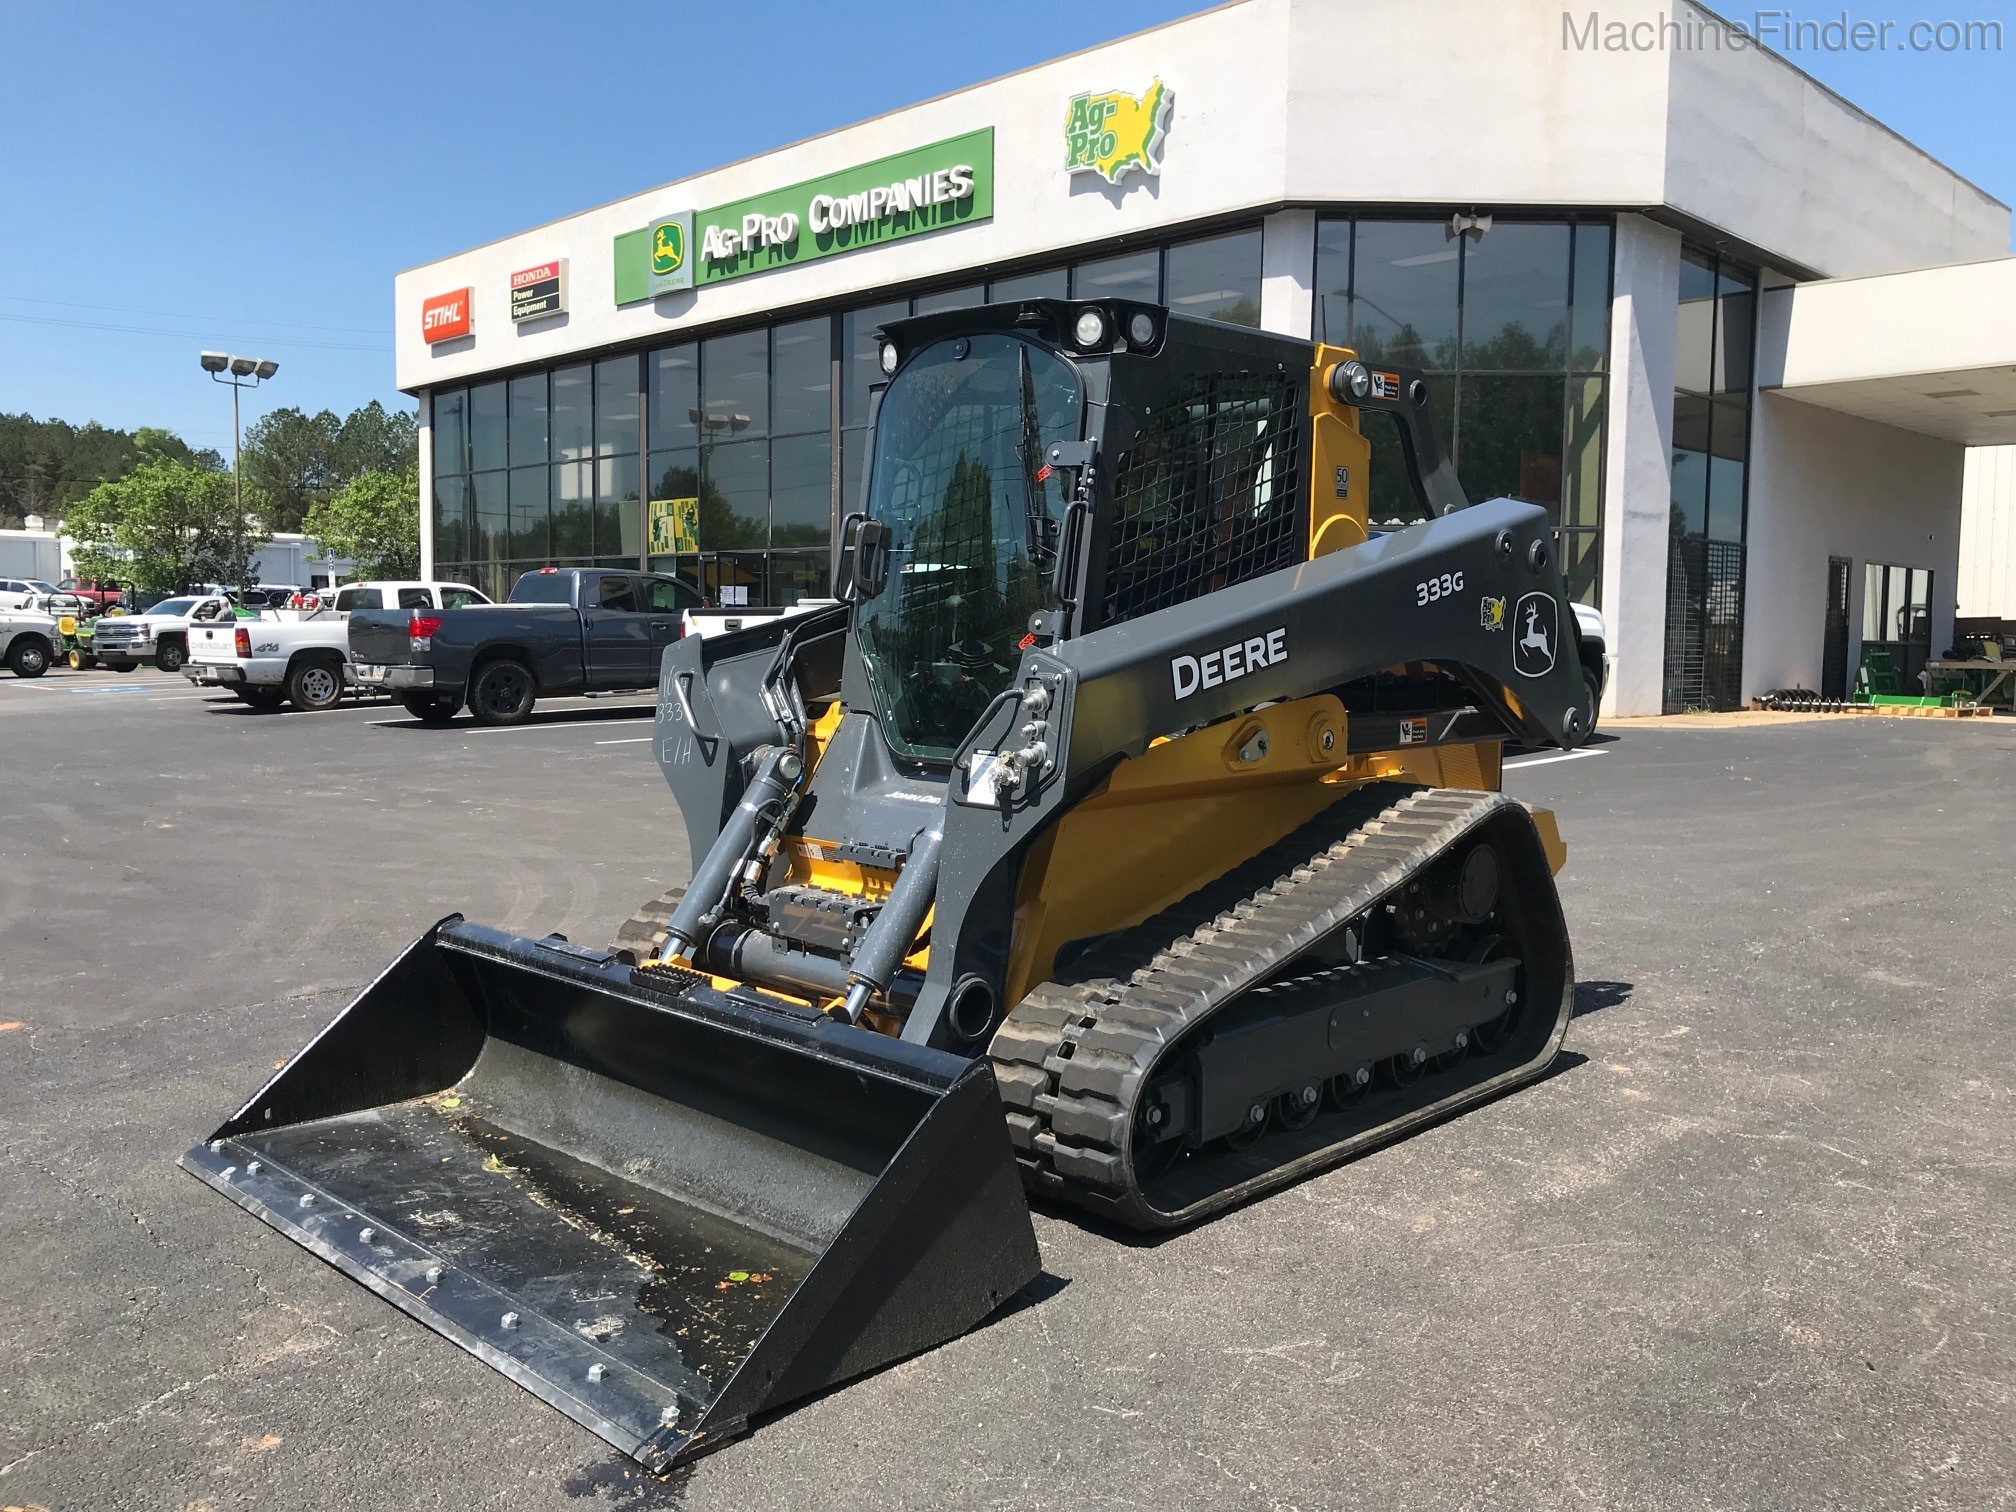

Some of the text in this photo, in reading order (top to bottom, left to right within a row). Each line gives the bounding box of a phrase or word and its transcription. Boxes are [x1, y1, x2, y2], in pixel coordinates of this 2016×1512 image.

[1066, 97, 1117, 136] Ag-
[1066, 131, 1117, 168] Pro
[513, 267, 551, 286] HONDA
[513, 289, 534, 302] Power
[513, 300, 547, 316] Equipment
[424, 302, 461, 330] STIHL
[1337, 468, 1348, 483] 50
[1416, 571, 1464, 606] 333G
[1171, 627, 1288, 700] DEERE
[659, 702, 683, 724] 333
[662, 736, 693, 765] E/H
